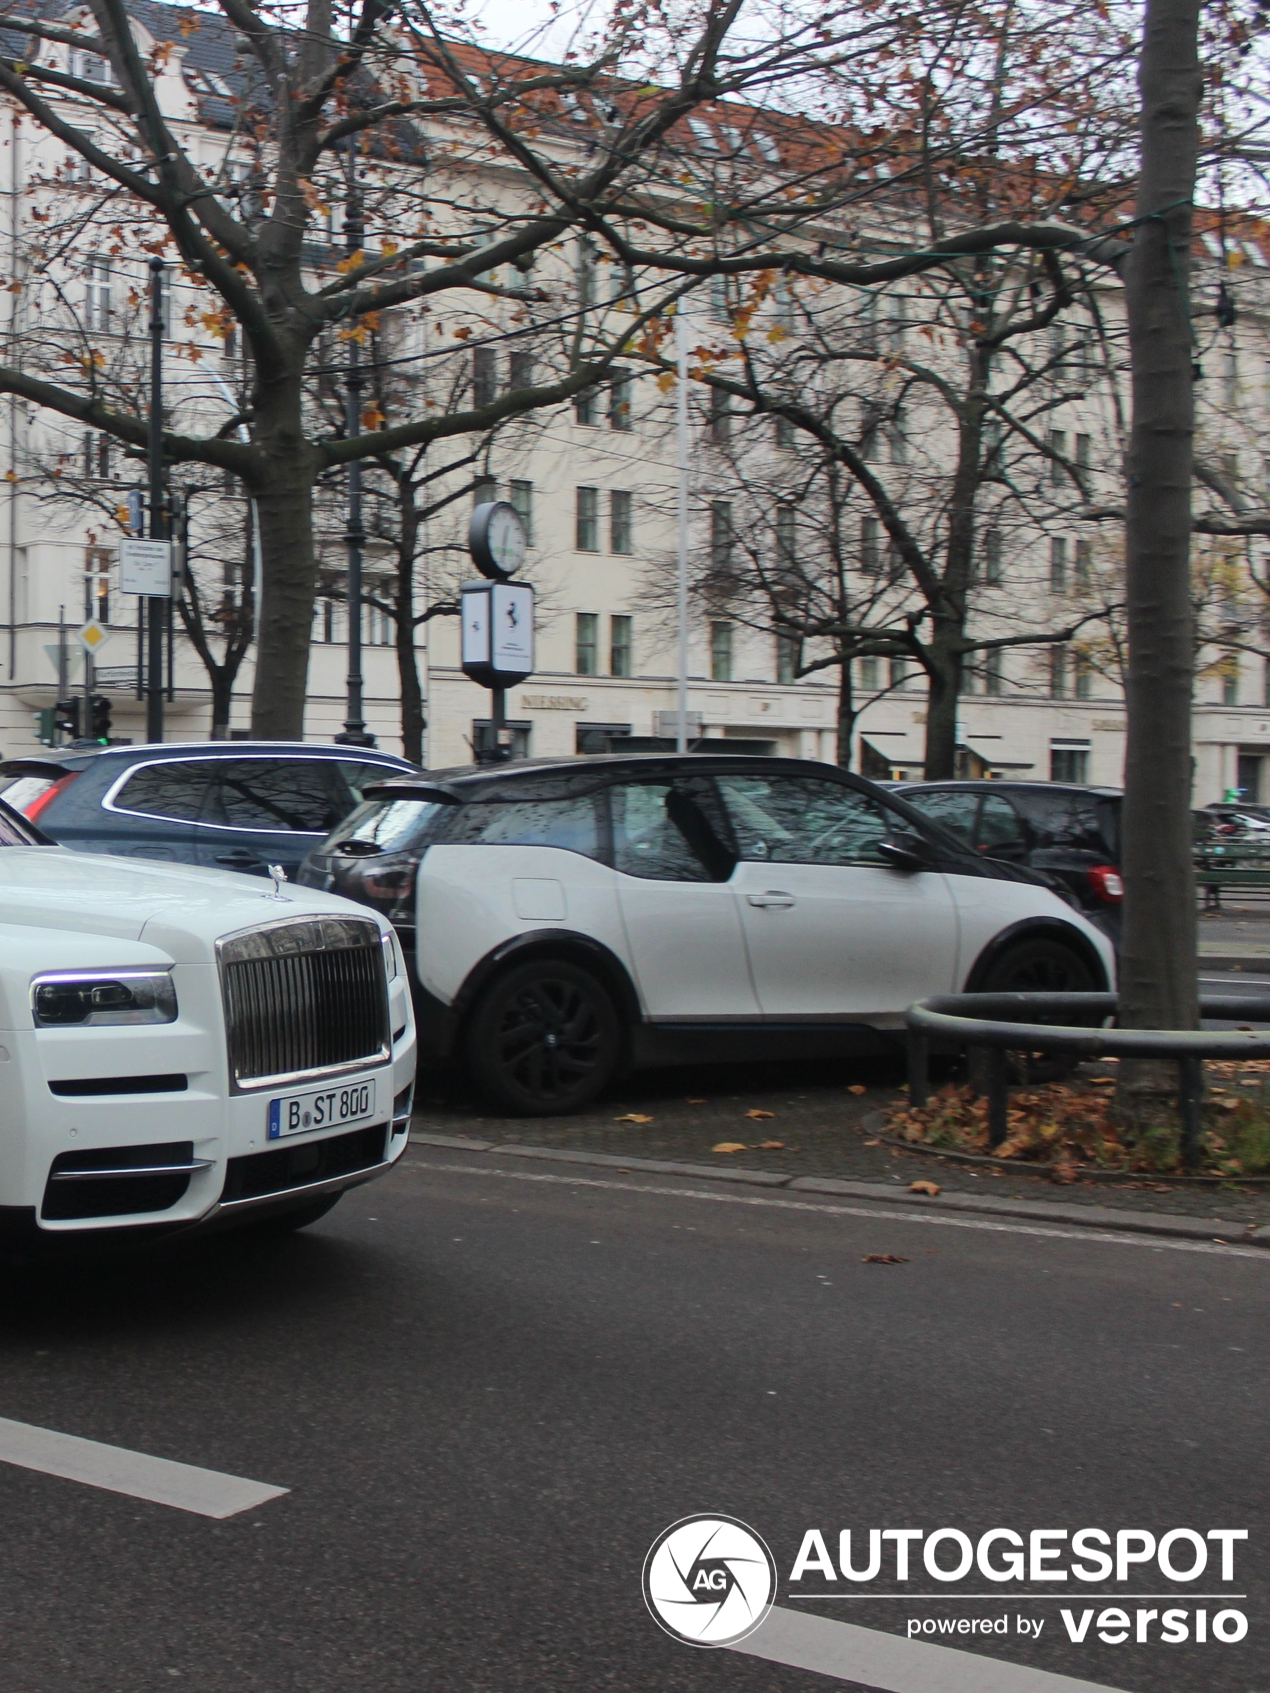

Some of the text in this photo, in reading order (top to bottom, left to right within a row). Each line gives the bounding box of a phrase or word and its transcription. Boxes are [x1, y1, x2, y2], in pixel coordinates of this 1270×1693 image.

[289, 1086, 368, 1129] B ST 800
[272, 1123, 277, 1131] D
